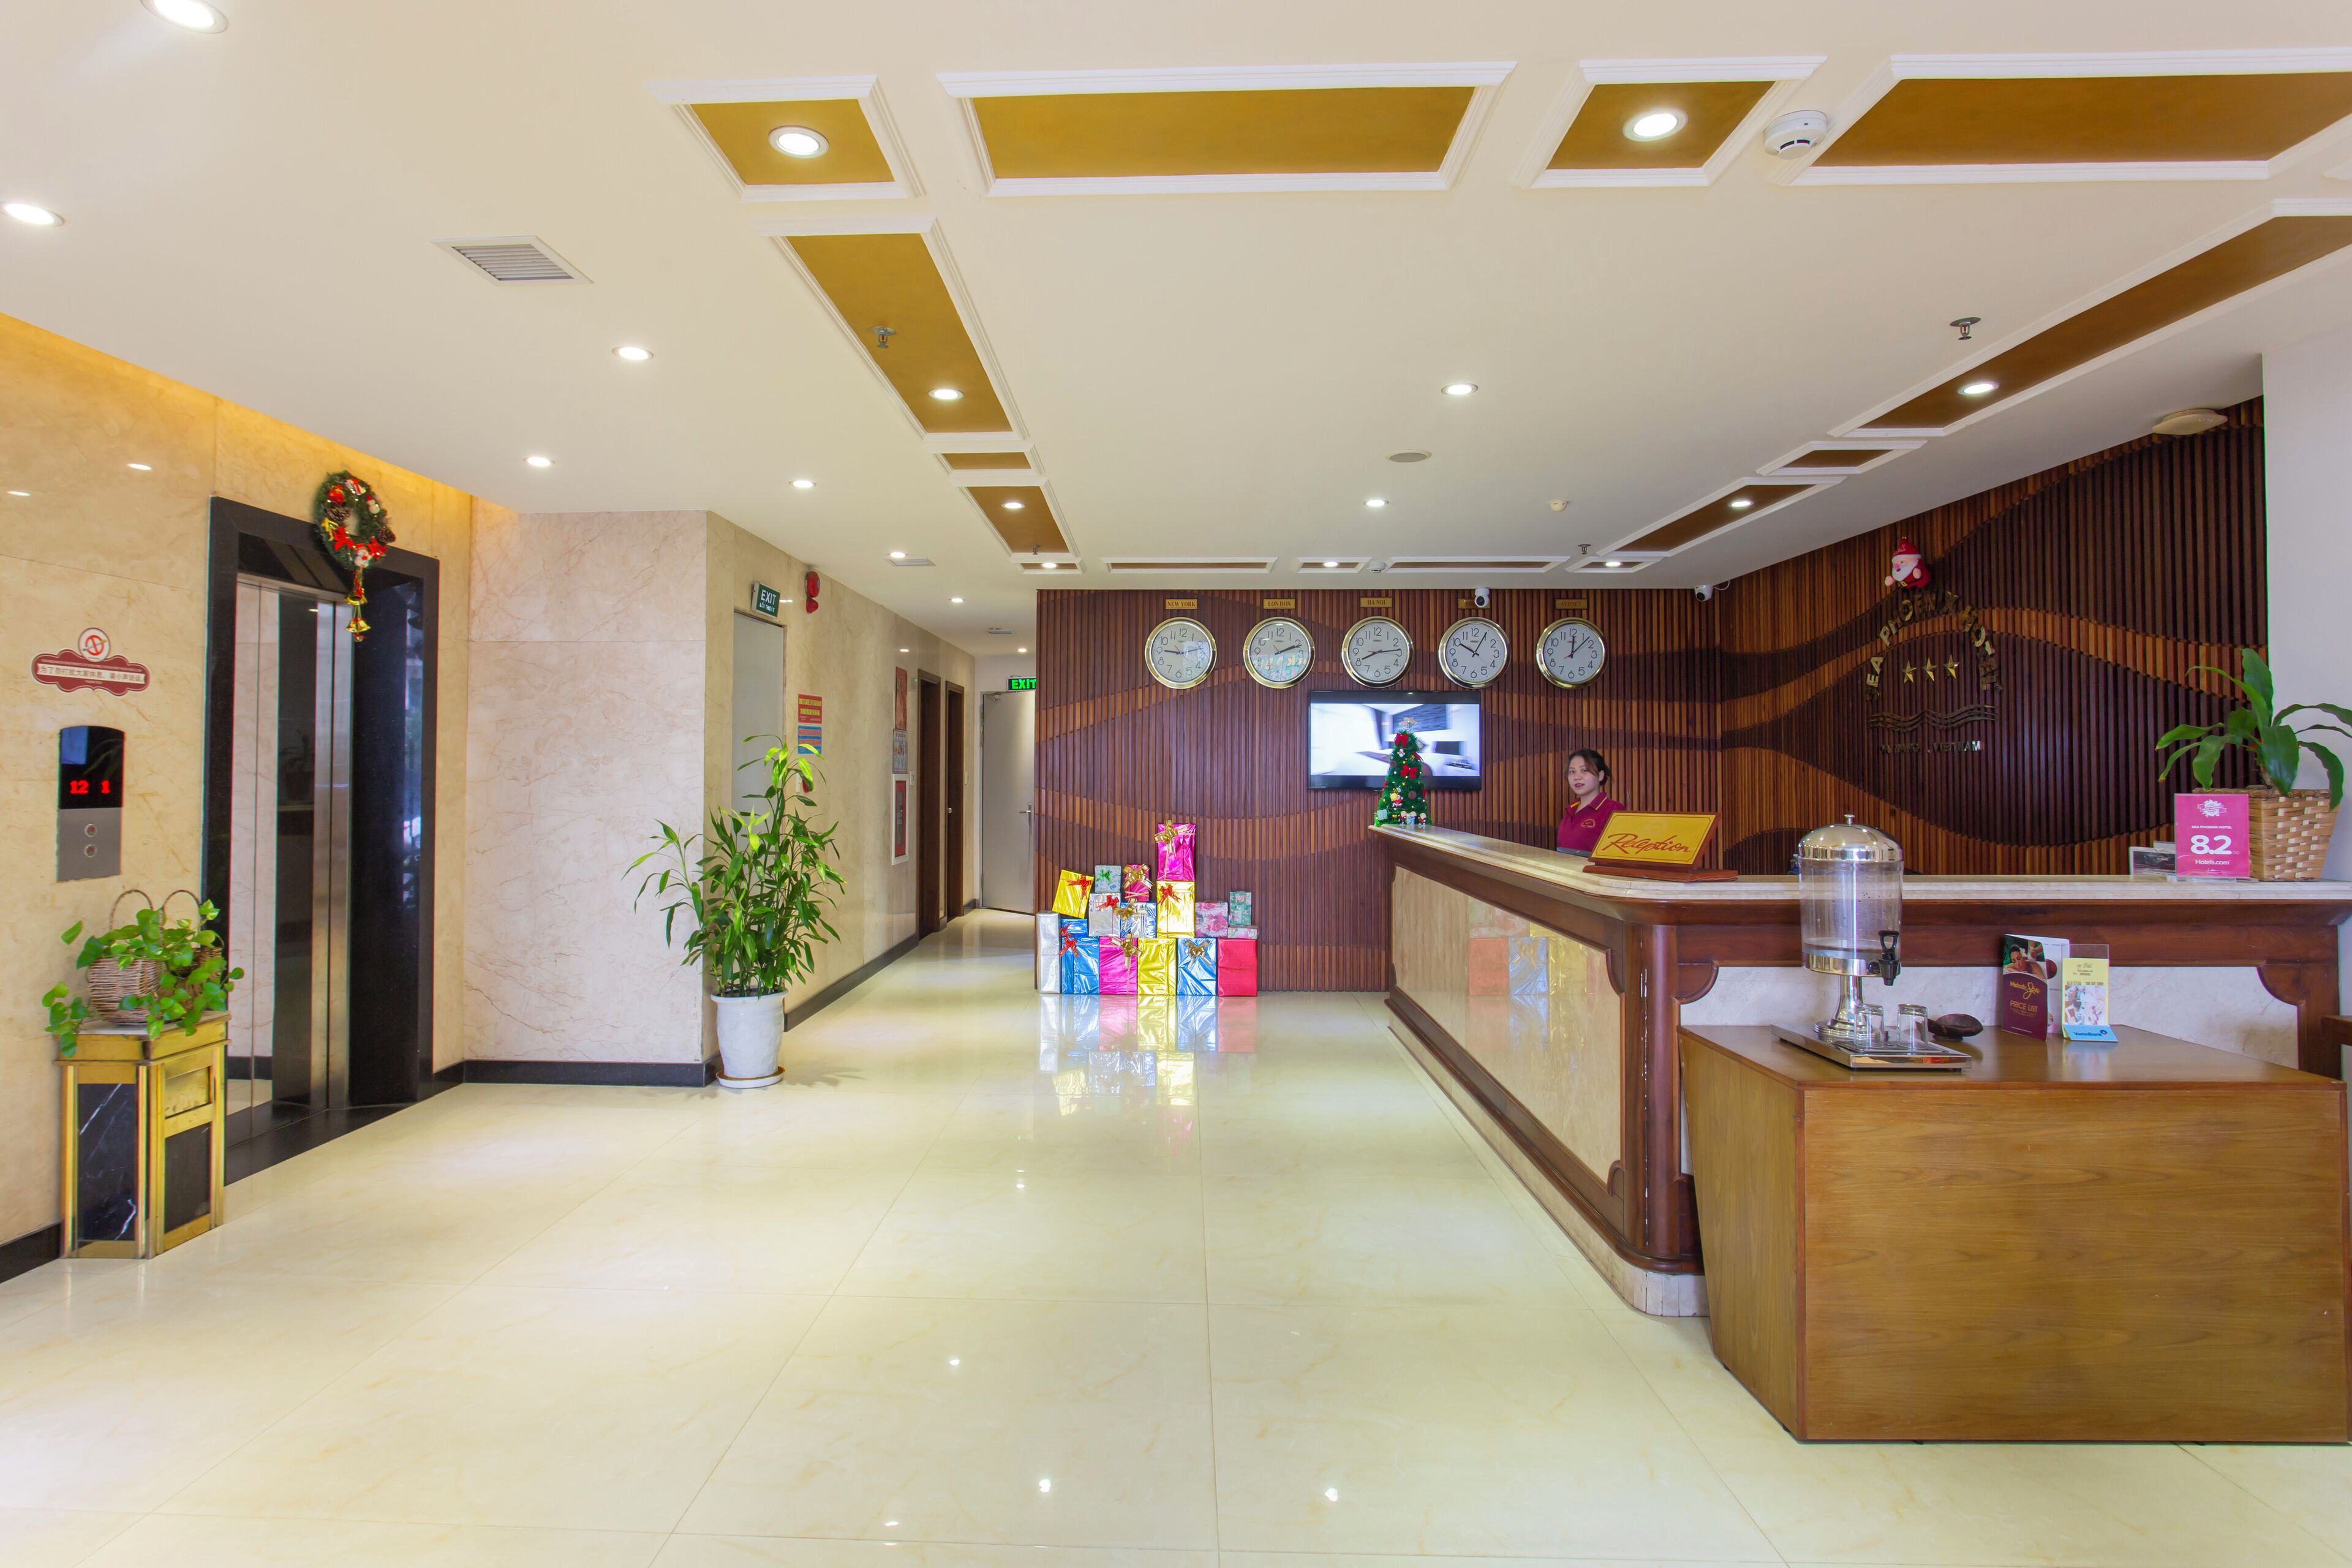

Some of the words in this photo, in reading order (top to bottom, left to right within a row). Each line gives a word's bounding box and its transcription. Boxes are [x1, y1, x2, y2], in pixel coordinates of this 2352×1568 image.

[761, 589, 777, 605] EXIT
[1170, 631, 1176, 639] 11
[1180, 628, 1187, 637] 12
[1268, 631, 1273, 639] 11
[1276, 628, 1284, 636] 12
[1365, 631, 1370, 639] 11
[1374, 627, 1381, 636] 12
[1463, 631, 1468, 640] 11
[1471, 628, 1479, 637] 12
[1570, 628, 1577, 637] 12
[1161, 636, 1168, 645] 10
[1356, 638, 1363, 646] 10
[1588, 640, 1594, 649] 2
[1449, 648, 1456, 657] 9
[1547, 648, 1553, 657] 9
[1355, 658, 1362, 666] 8
[1167, 665, 1172, 673] 7
[1175, 669, 1182, 678] 6
[1186, 667, 1192, 676] 5
[1286, 666, 1291, 675] 5
[1374, 669, 1381, 677] 6
[1461, 666, 1466, 674] 7
[1481, 666, 1487, 675] 5
[1559, 666, 1564, 674] 7
[1578, 667, 1585, 676] 5
[1568, 670, 1574, 679] 6
[1011, 679, 1037, 689] EXIT
[1933, 741, 1981, 752] VIETNAM
[70, 780, 89, 794] 12
[101, 780, 110, 794] 1
[1601, 833, 1691, 854] Reception
[2190, 835, 2232, 854] 8.2
[2010, 981, 2026, 990] Melody
[2023, 982, 2040, 1000] Spa
[2010, 1000, 2027, 1010] PRICE
